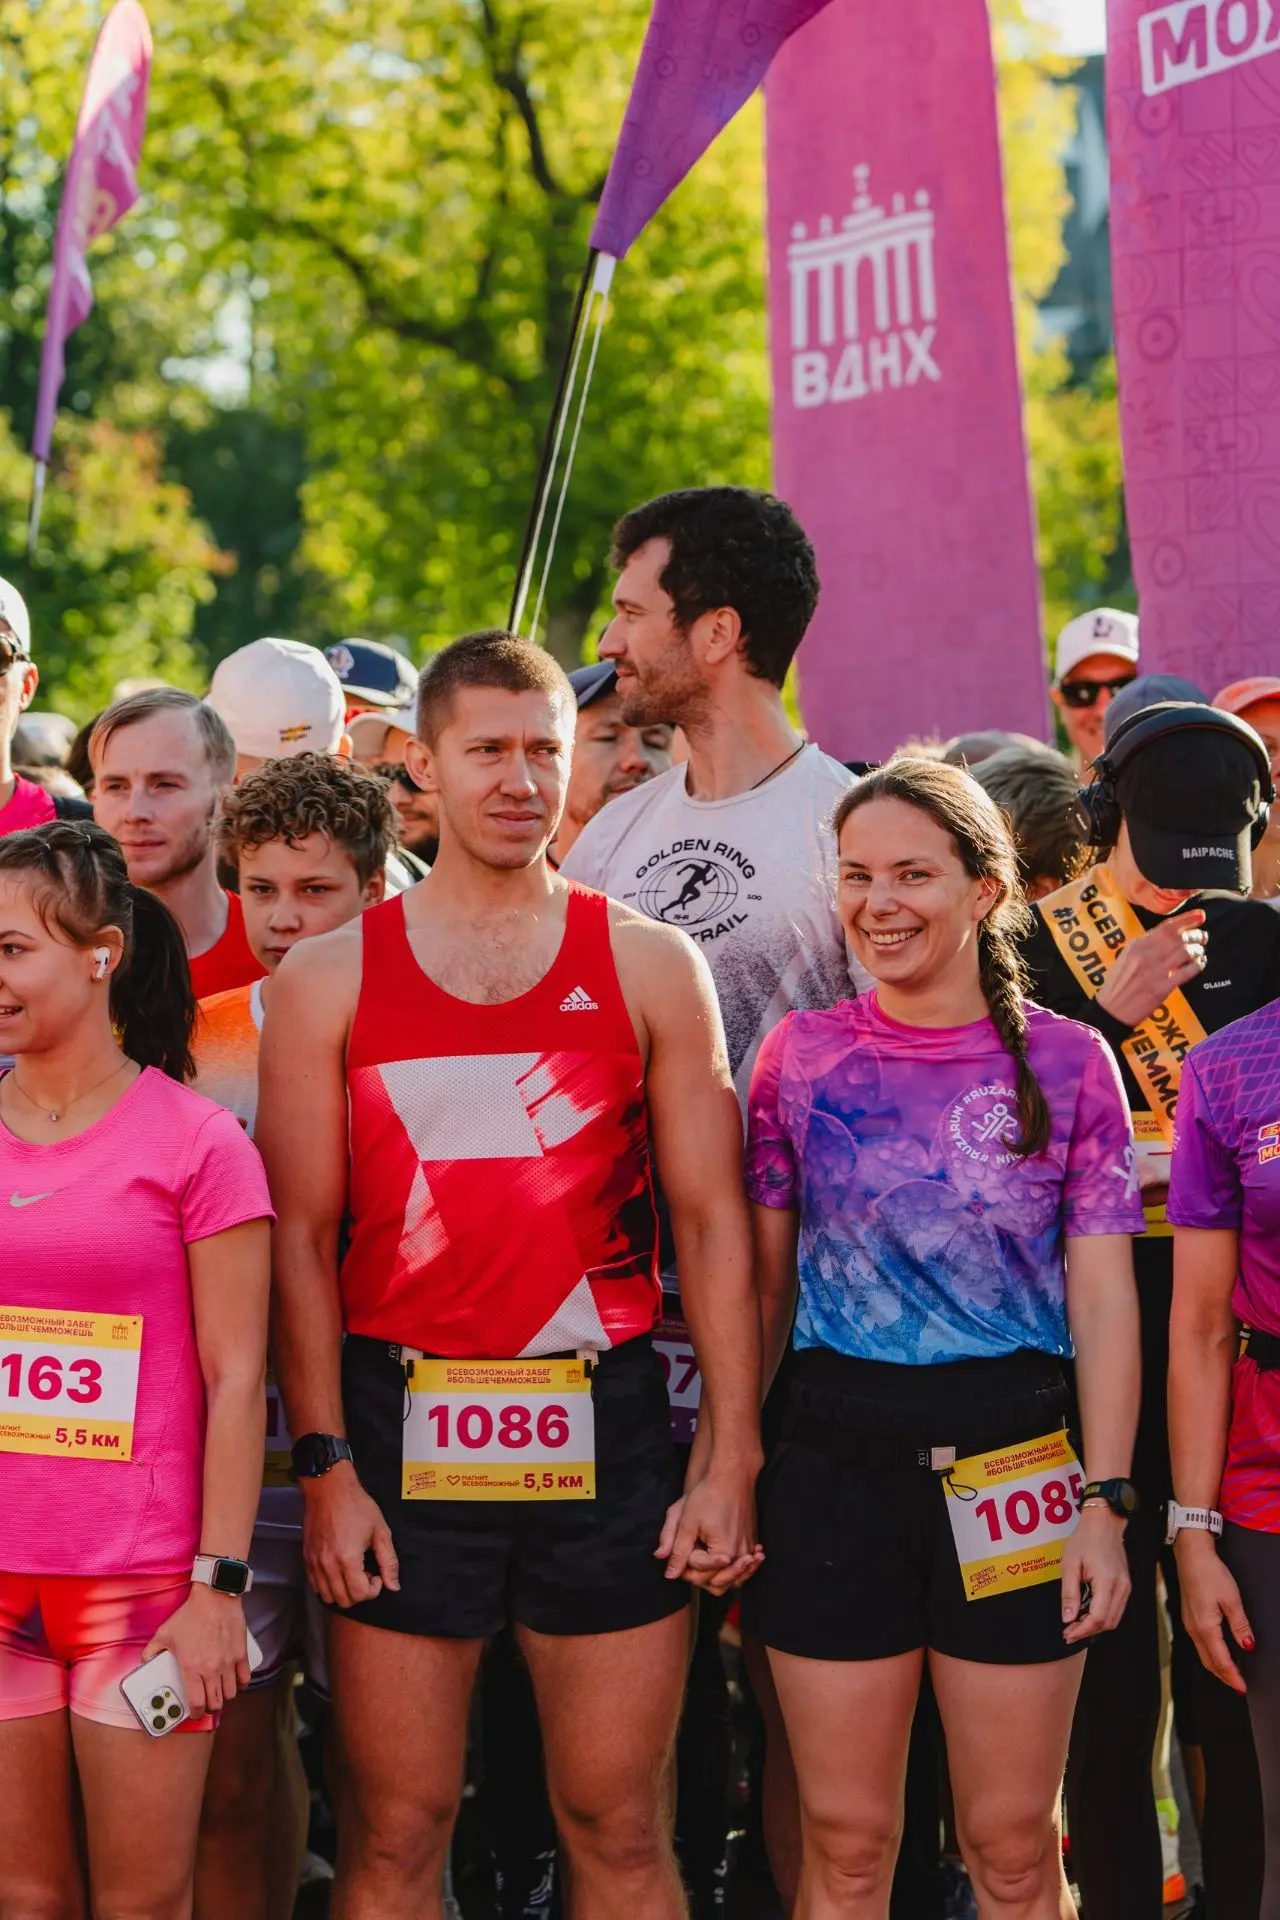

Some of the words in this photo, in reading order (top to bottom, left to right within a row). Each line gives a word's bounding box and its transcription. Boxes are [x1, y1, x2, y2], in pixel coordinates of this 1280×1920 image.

[792, 326, 940, 408] ВДНХ
[636, 839, 710, 879] GOLDEN
[713, 842, 756, 880] RING
[1182, 847, 1236, 860] NAIPACHE
[690, 913, 748, 942] TRAIL
[559, 1001, 599, 1012] adidas
[67, 1320, 96, 1329] ЗАБЕГ
[1, 1353, 103, 1403] 163
[447, 1368, 524, 1376] ВСЕВОЗМОЖНЫЙ
[526, 1368, 552, 1376] ЗАБЕГ
[447, 1377, 552, 1385] #БОЛЬШЕЧЕММОЖЕШЬ
[428, 1405, 570, 1449] 1086
[55, 1427, 88, 1448] 5,5
[984, 1445, 1049, 1470] ВСЕВОЗМОЖНЫЙ
[523, 1473, 554, 1492] 5,5
[1021, 1557, 1046, 1568] МАГНИТ
